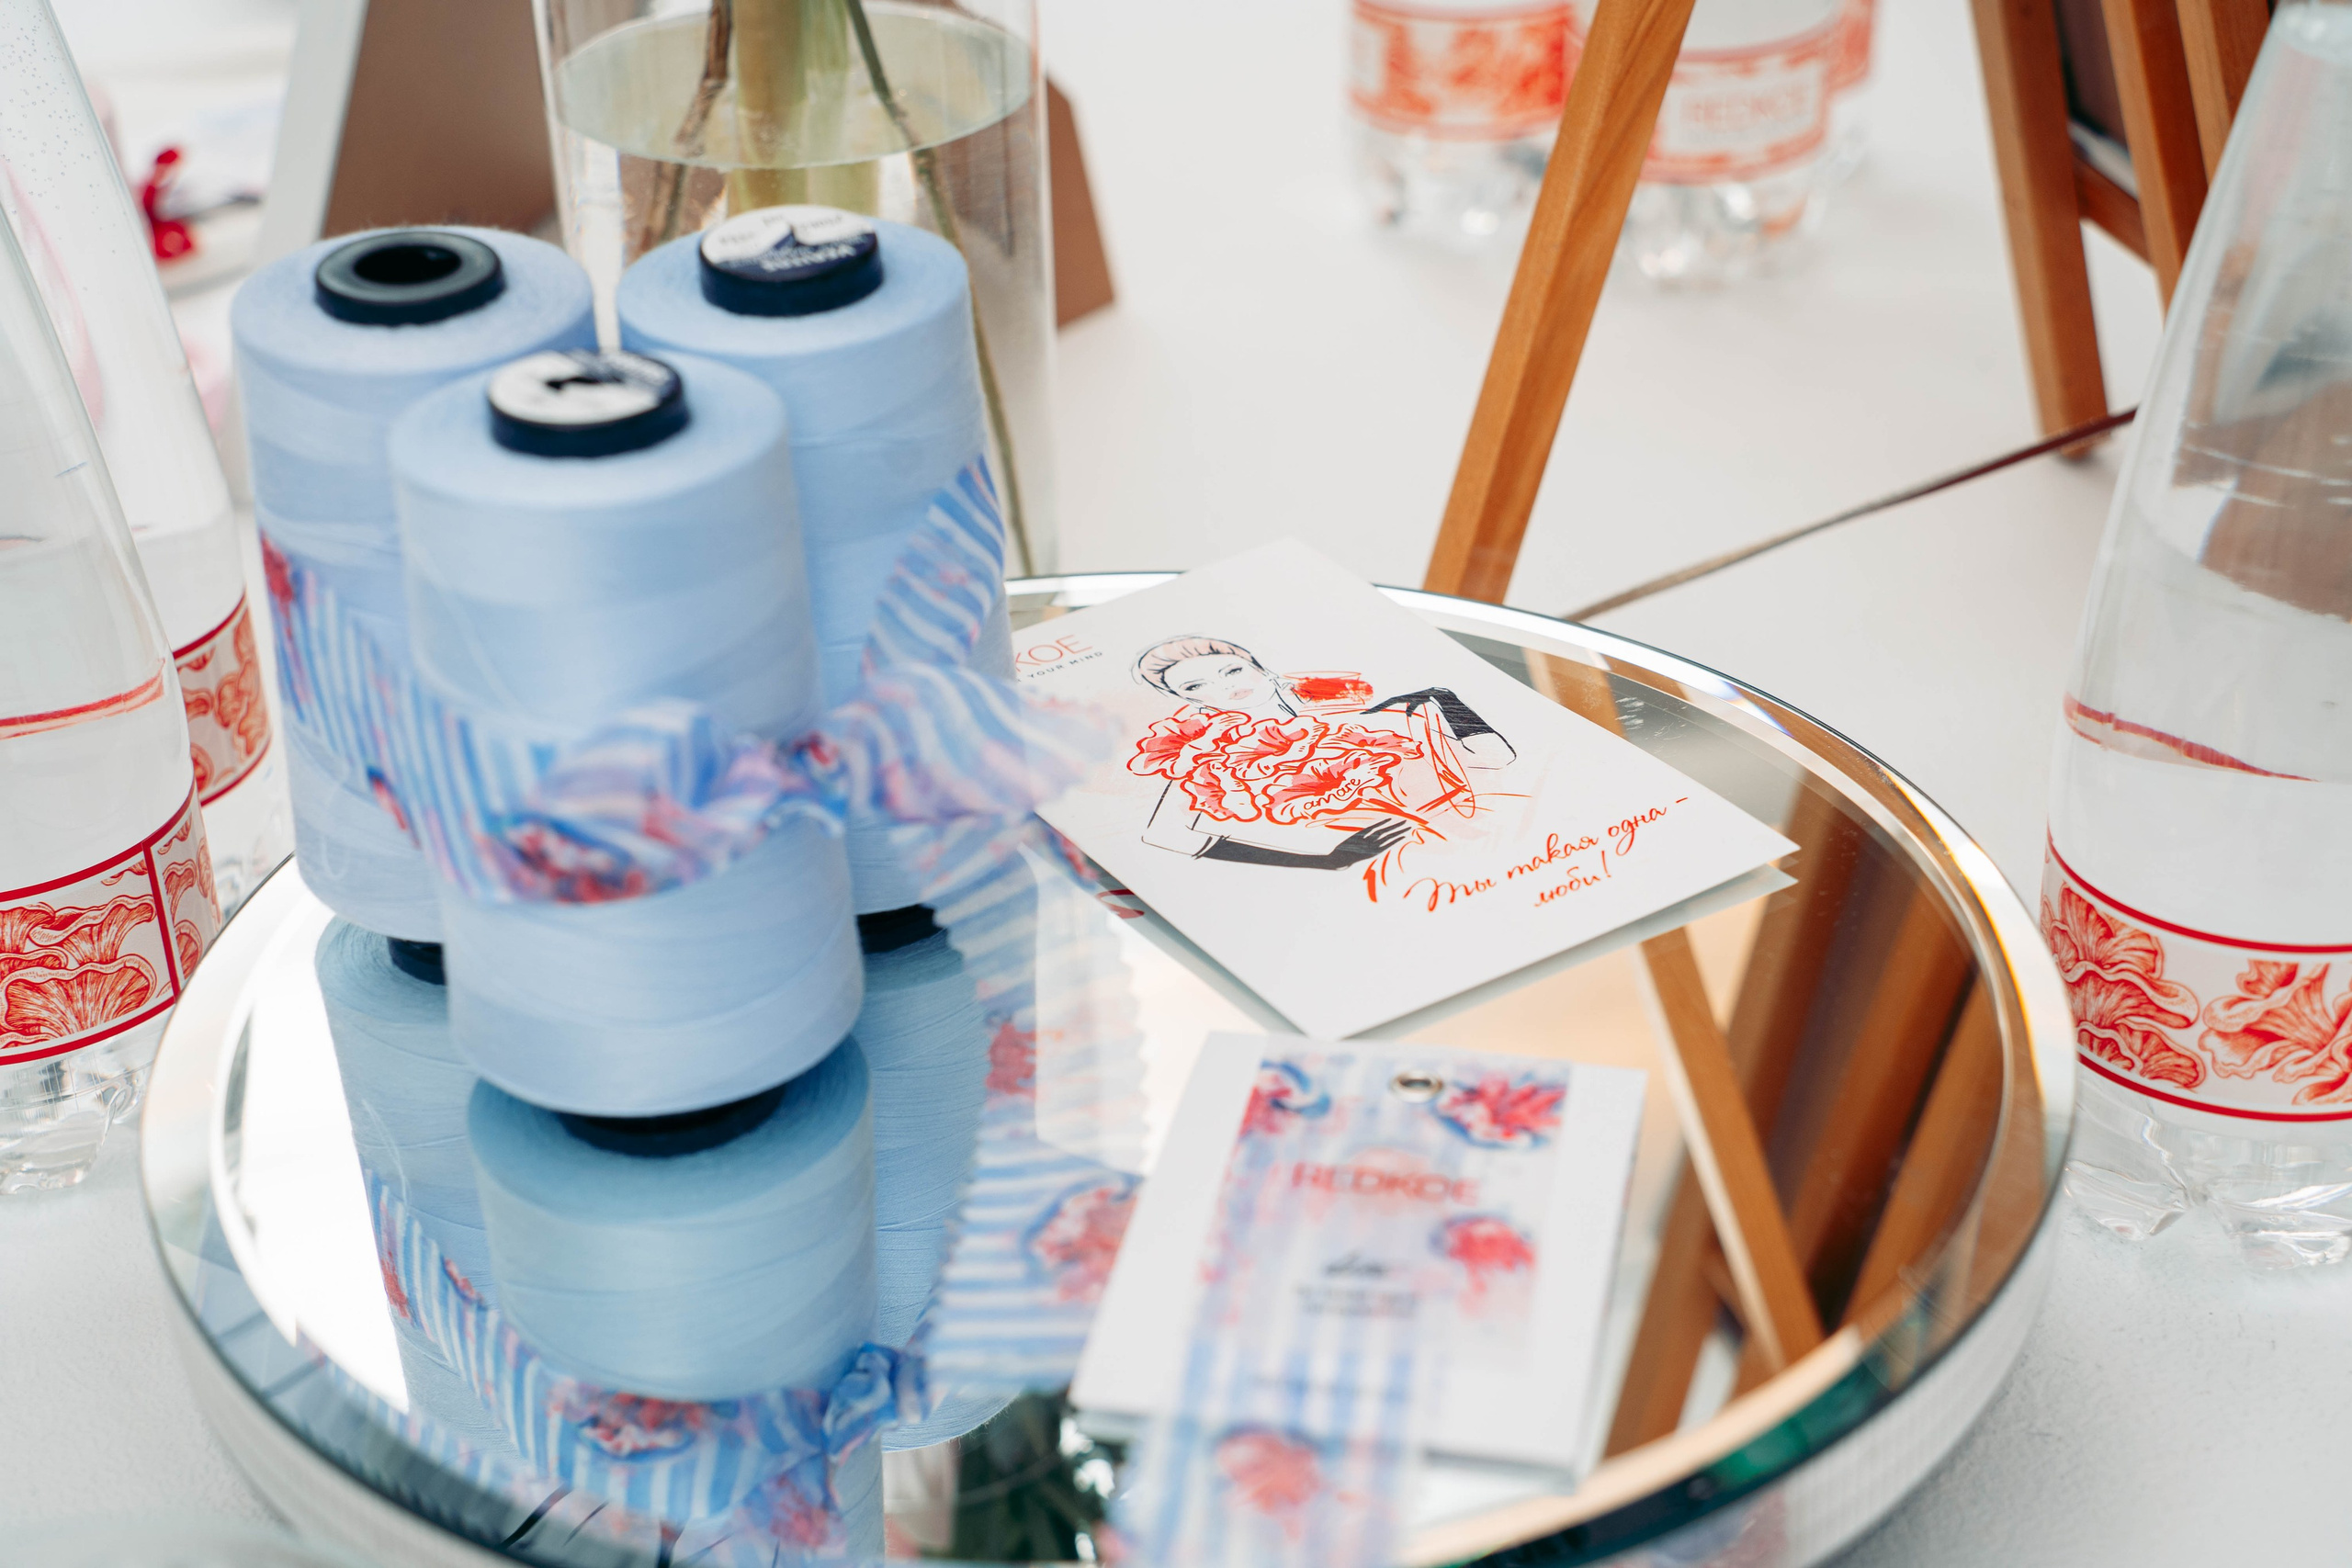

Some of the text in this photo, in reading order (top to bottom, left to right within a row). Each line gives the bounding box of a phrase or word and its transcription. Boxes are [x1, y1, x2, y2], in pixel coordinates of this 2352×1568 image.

[1027, 650, 1103, 679] YOUR MIND
[1402, 877, 1497, 912] Ты
[1507, 832, 1600, 879] такая
[1607, 806, 1668, 856] одна
[1533, 850, 1612, 908] люби!
